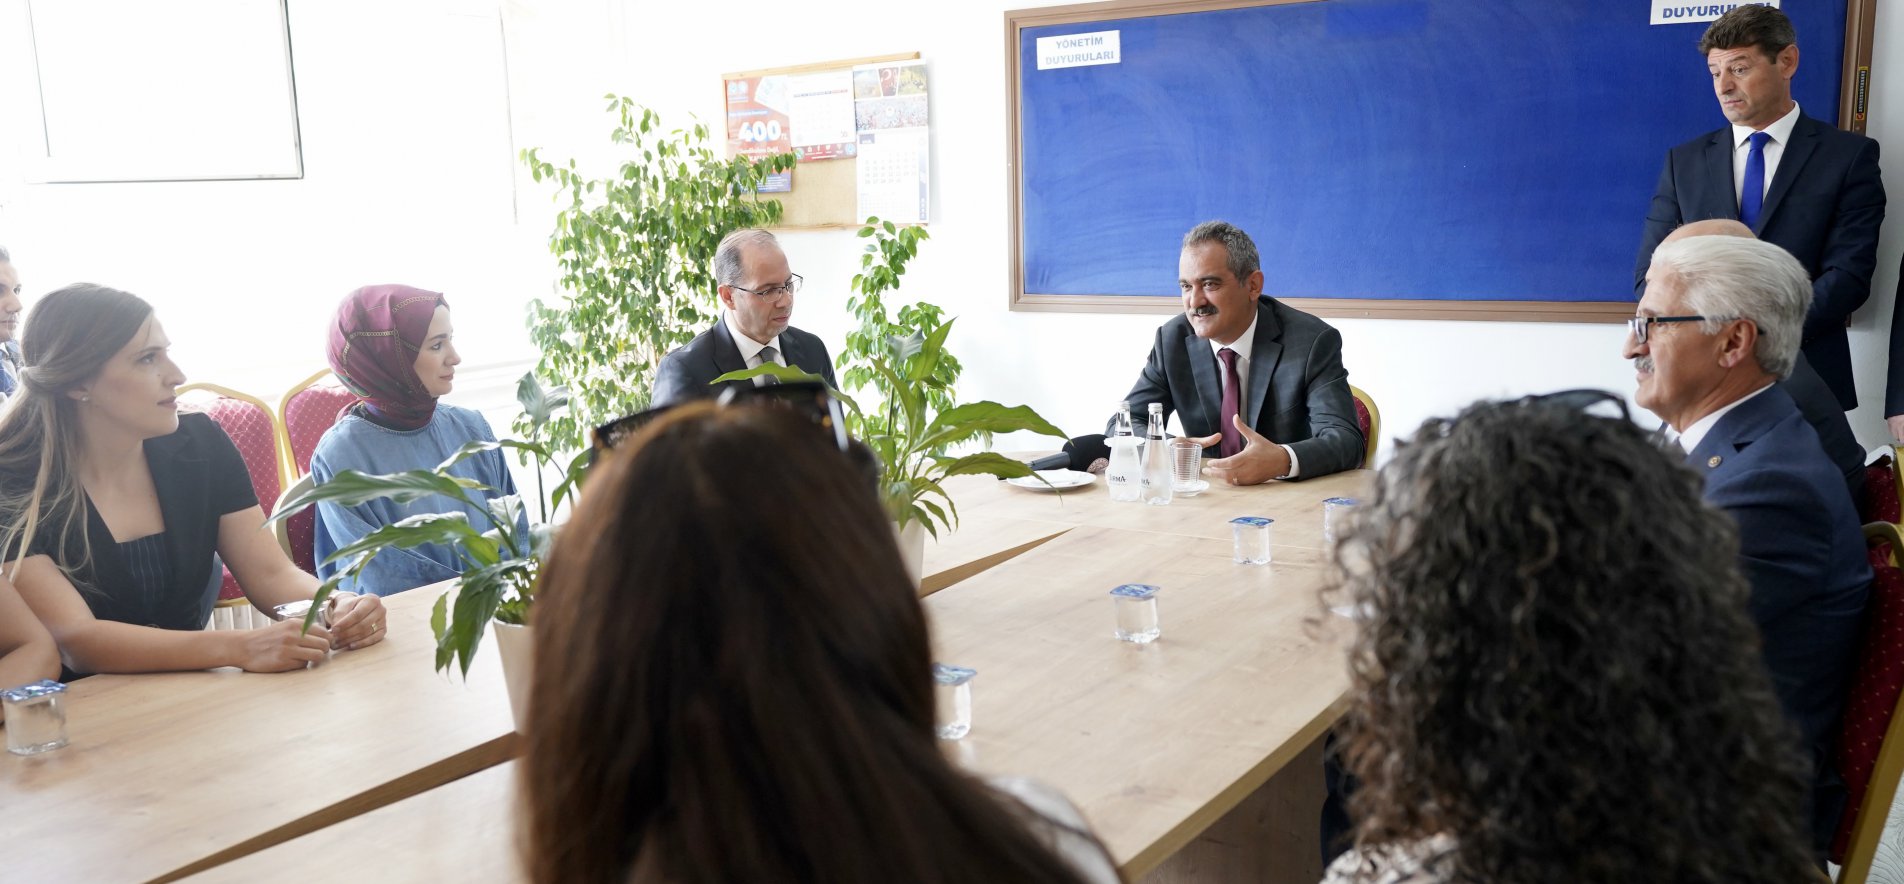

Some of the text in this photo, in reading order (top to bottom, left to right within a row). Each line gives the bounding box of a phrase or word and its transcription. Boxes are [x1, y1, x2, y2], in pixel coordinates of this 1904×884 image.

[1662, 2, 1771, 19] DUYURU
[1056, 36, 1103, 49] YÖNETİM
[1045, 51, 1114, 65] DUYURULARI
[738, 119, 782, 142] 400
